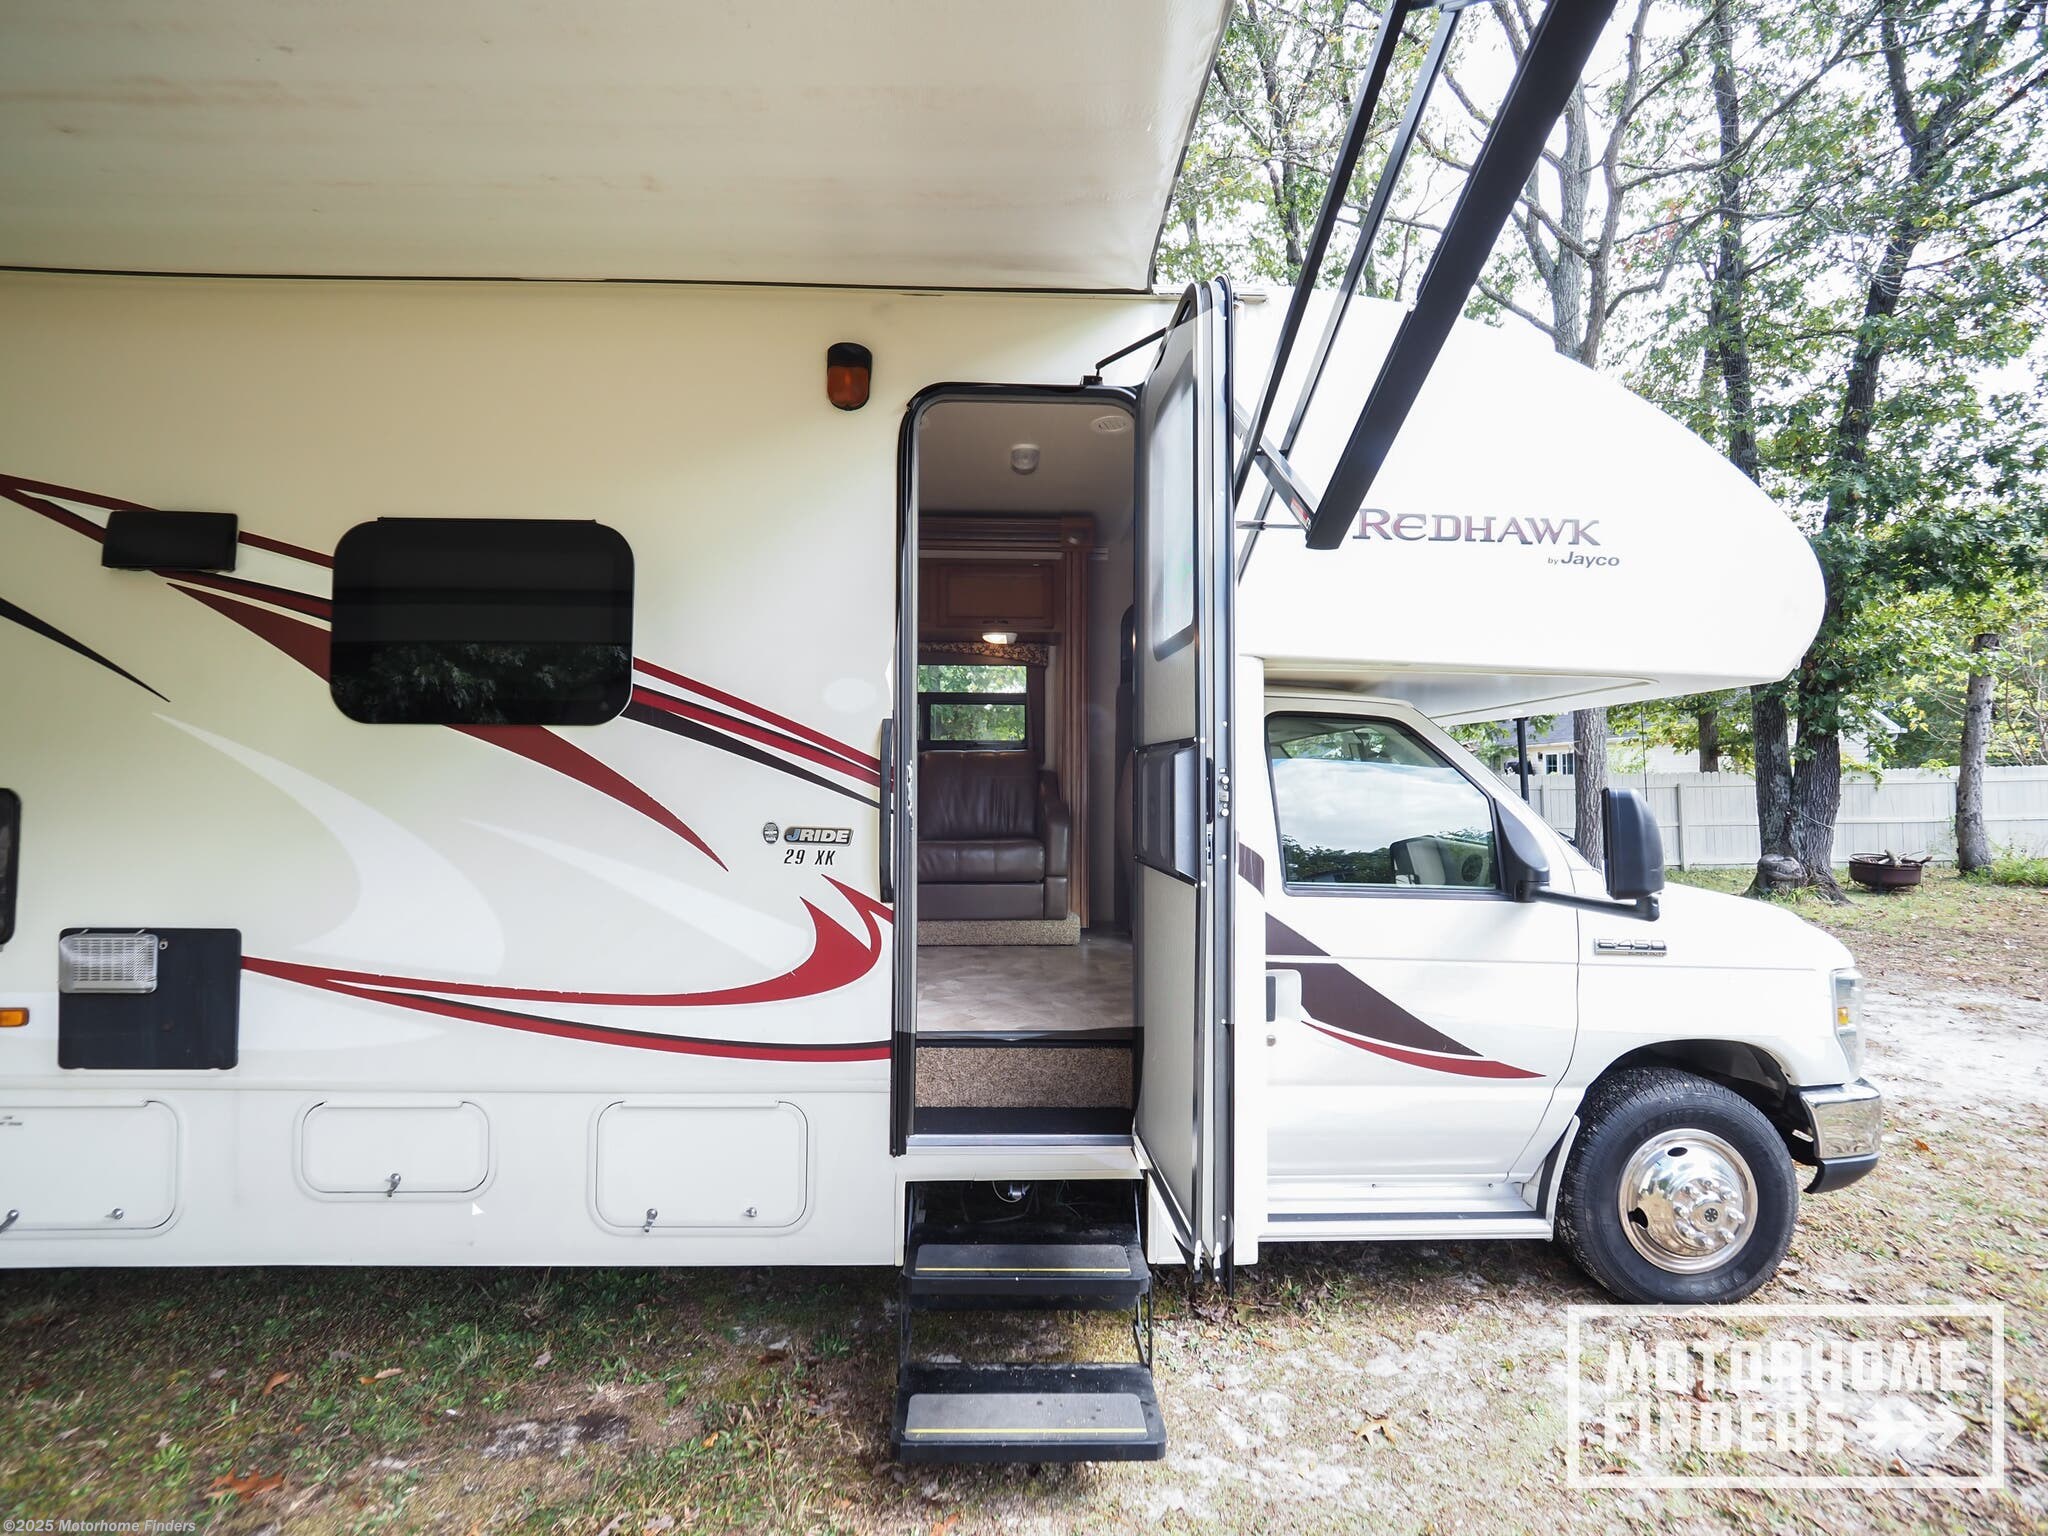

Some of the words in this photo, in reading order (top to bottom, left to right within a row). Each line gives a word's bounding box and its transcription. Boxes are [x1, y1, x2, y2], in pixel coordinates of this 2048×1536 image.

[1352, 508, 1601, 546] REDHAWK
[1547, 556, 1559, 566] by
[1561, 551, 1620, 568] Jayco
[785, 828, 850, 843] JRIDE
[784, 849, 806, 865] 29
[815, 849, 836, 866] XK
